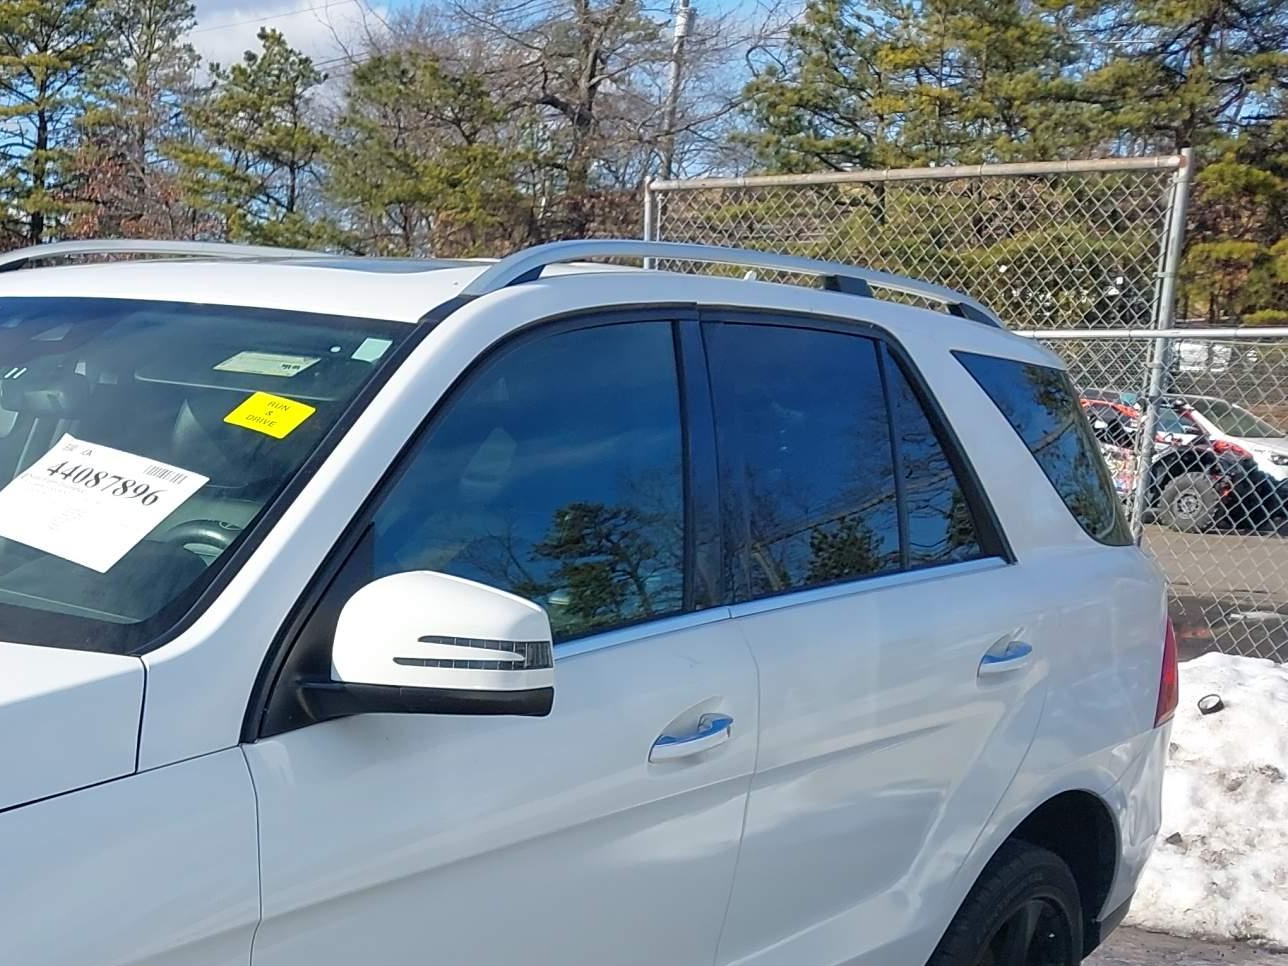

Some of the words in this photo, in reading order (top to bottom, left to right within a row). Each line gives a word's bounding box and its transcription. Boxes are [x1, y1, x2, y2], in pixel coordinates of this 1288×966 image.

[267, 401, 291, 412] RUN
[245, 414, 278, 428] DRIVE
[47, 460, 168, 506] 44087896
